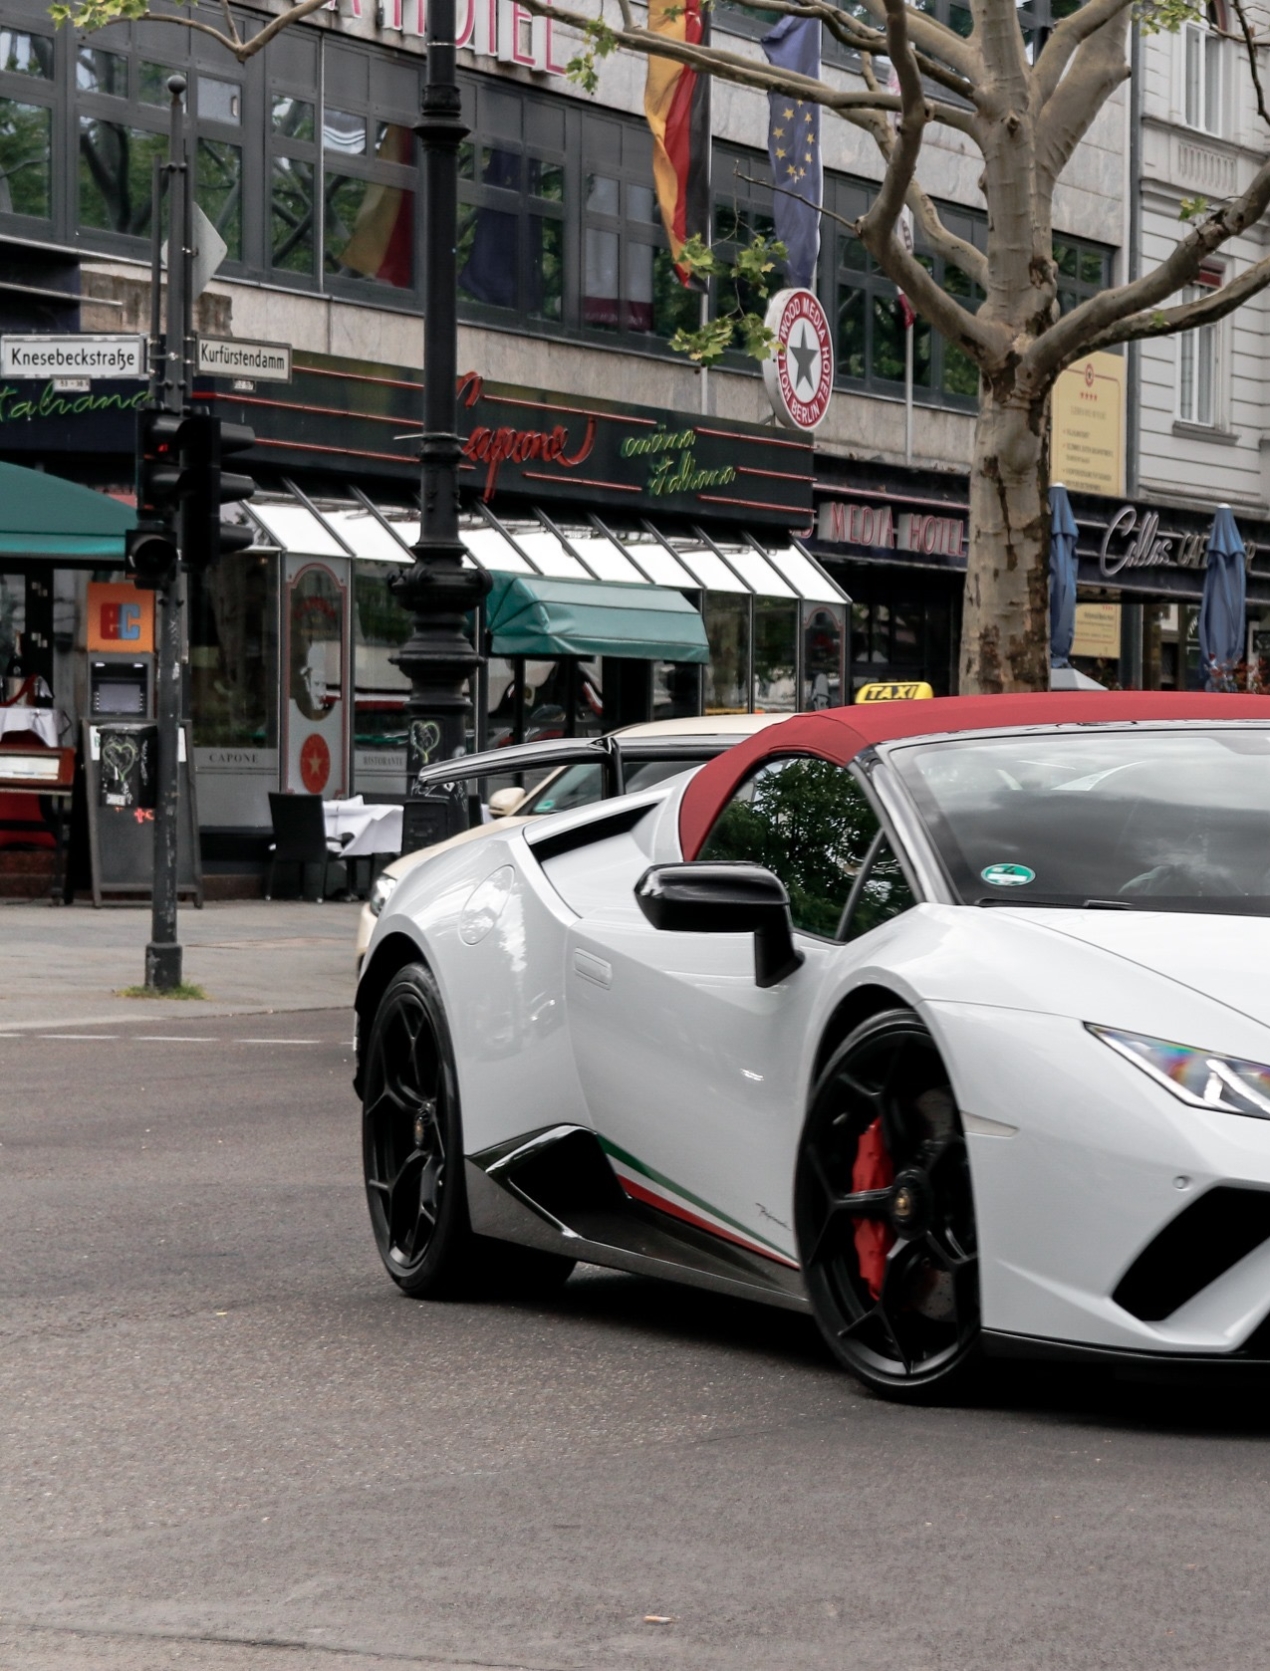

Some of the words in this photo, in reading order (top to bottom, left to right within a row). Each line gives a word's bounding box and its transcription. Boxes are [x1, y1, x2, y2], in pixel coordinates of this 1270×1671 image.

[12, 348, 135, 371] Knesebeckstraße
[201, 343, 285, 370] Kurfürstendamm
[778, 297, 801, 402] HOLLWOOD
[803, 296, 826, 343] MEDIA
[818, 346, 831, 403] HOTEL
[791, 402, 820, 424] BERLIN
[830, 501, 895, 549] MEDIA
[908, 513, 966, 557] HOTEL
[865, 685, 919, 700] TAXI
[209, 754, 258, 764] CAPONE
